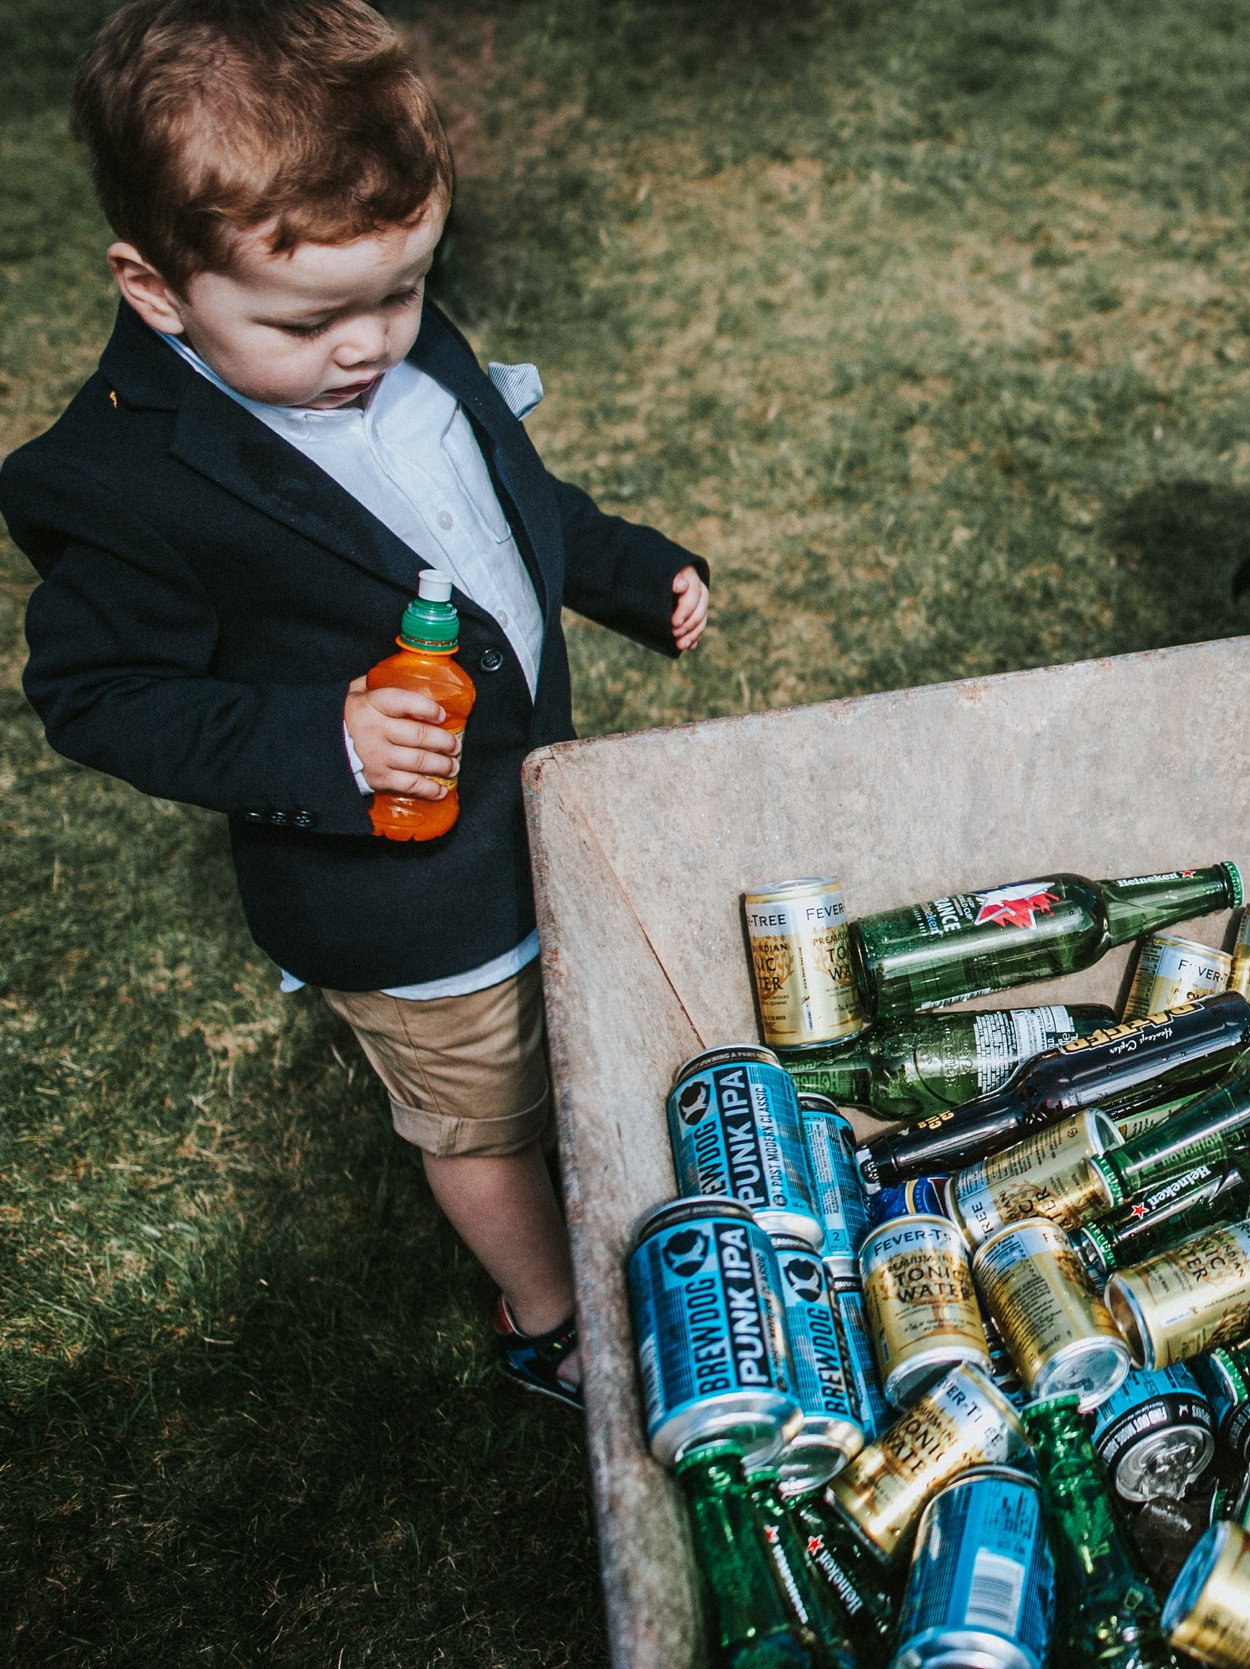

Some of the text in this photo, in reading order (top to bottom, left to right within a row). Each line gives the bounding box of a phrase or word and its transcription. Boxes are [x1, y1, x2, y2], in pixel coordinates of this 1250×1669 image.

[1117, 872, 1179, 887] Heineken
[933, 896, 961, 932] RANCE
[1178, 958, 1229, 983] FVER-T
[694, 1120, 728, 1196] EWDOG
[719, 1070, 766, 1206] PUNK IPA
[755, 1087, 783, 1187] POST MODERN CLASSIC
[1145, 1163, 1212, 1209] Heineken
[832, 1232, 840, 1241] 2
[971, 1201, 995, 1238] REE
[719, 1228, 752, 1279] IPA
[685, 1278, 731, 1395] BREWDOG
[727, 1287, 770, 1385] PUNK
[807, 1307, 849, 1416] BREWDOG
[1133, 1414, 1150, 1433] OUT
[811, 1548, 867, 1616] Heineken
